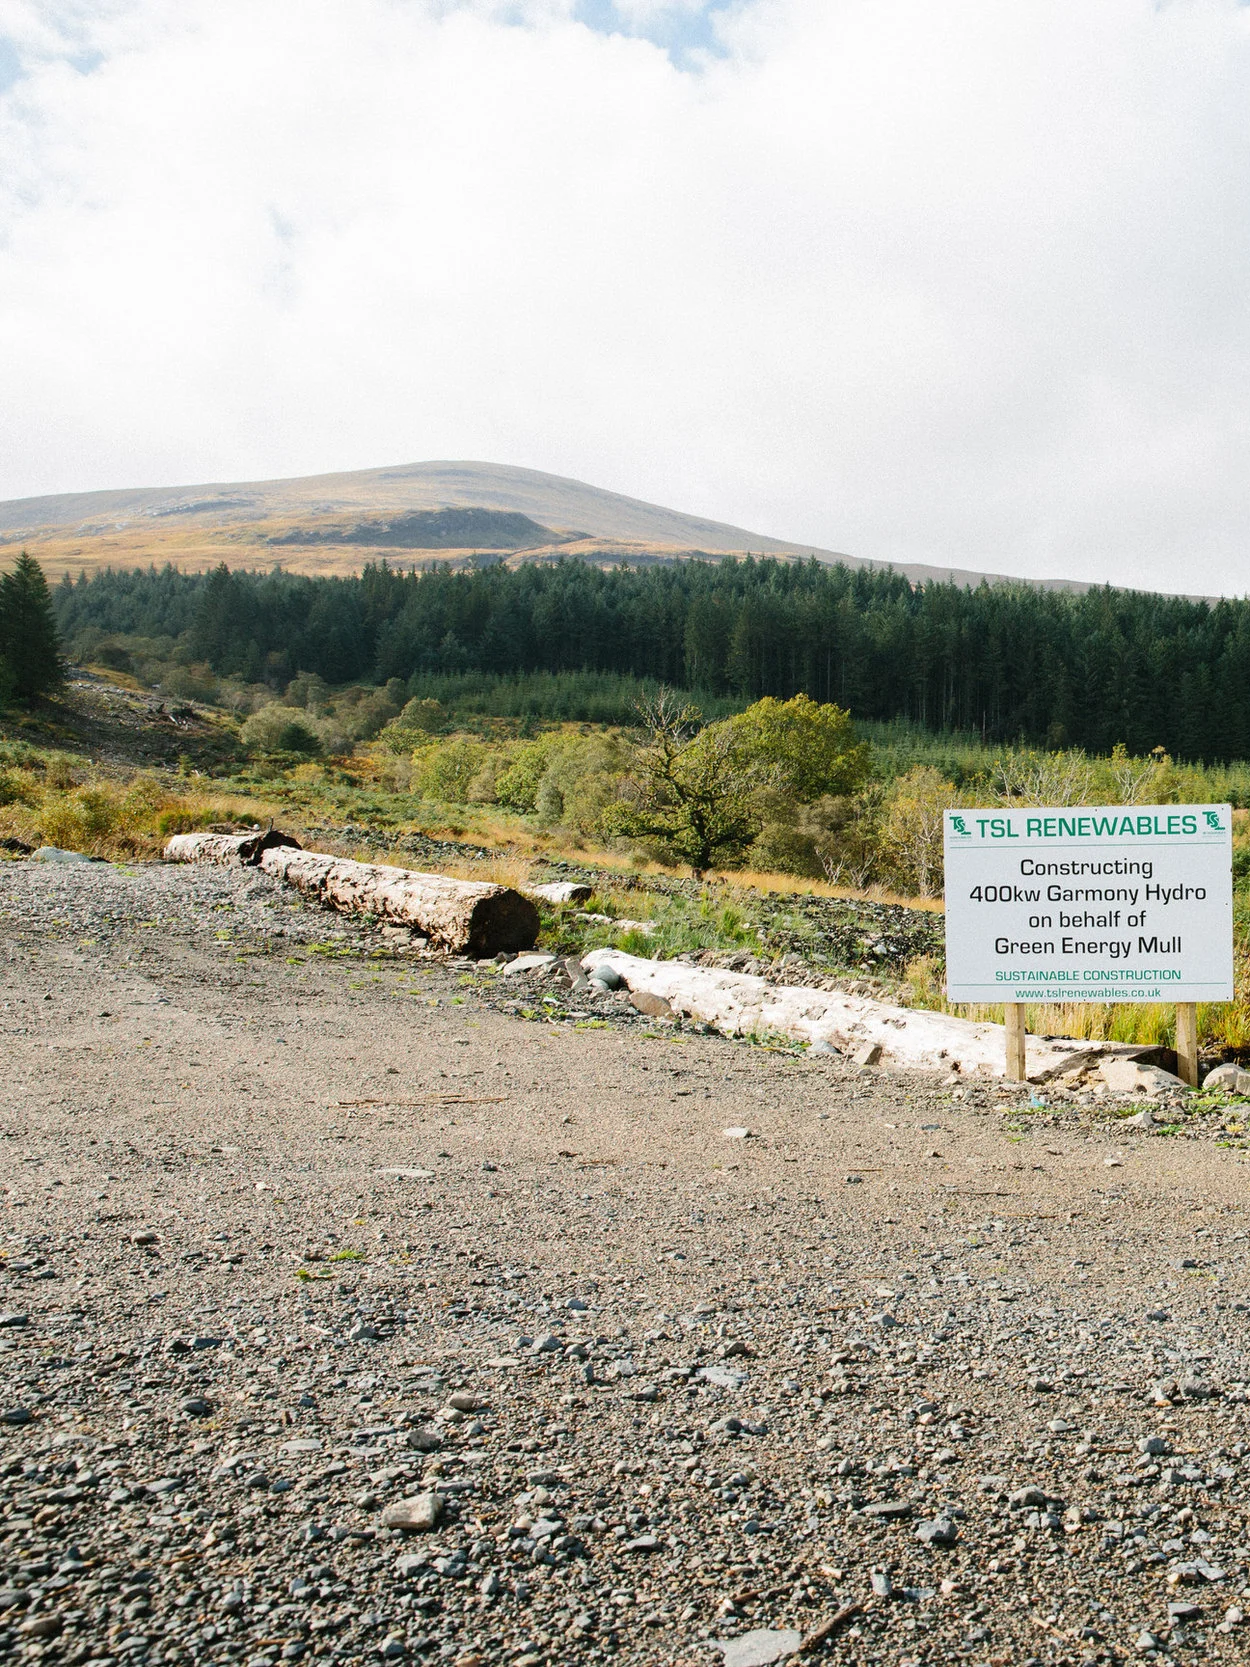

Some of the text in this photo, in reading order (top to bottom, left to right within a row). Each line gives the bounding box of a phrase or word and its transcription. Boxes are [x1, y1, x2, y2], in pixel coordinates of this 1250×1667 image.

[976, 815, 1197, 838] TSL RENEWABLES
[1020, 858, 1153, 878] Constructing
[970, 884, 1206, 905] 400kw Garmony Hydro
[1029, 910, 1146, 928] on behalf of
[995, 936, 1182, 958] Green Energy Mull
[995, 970, 1181, 981] SUSTAINABLE CONSTRUCTION
[1016, 988, 1161, 998] www.tslrenewables.co.uk
